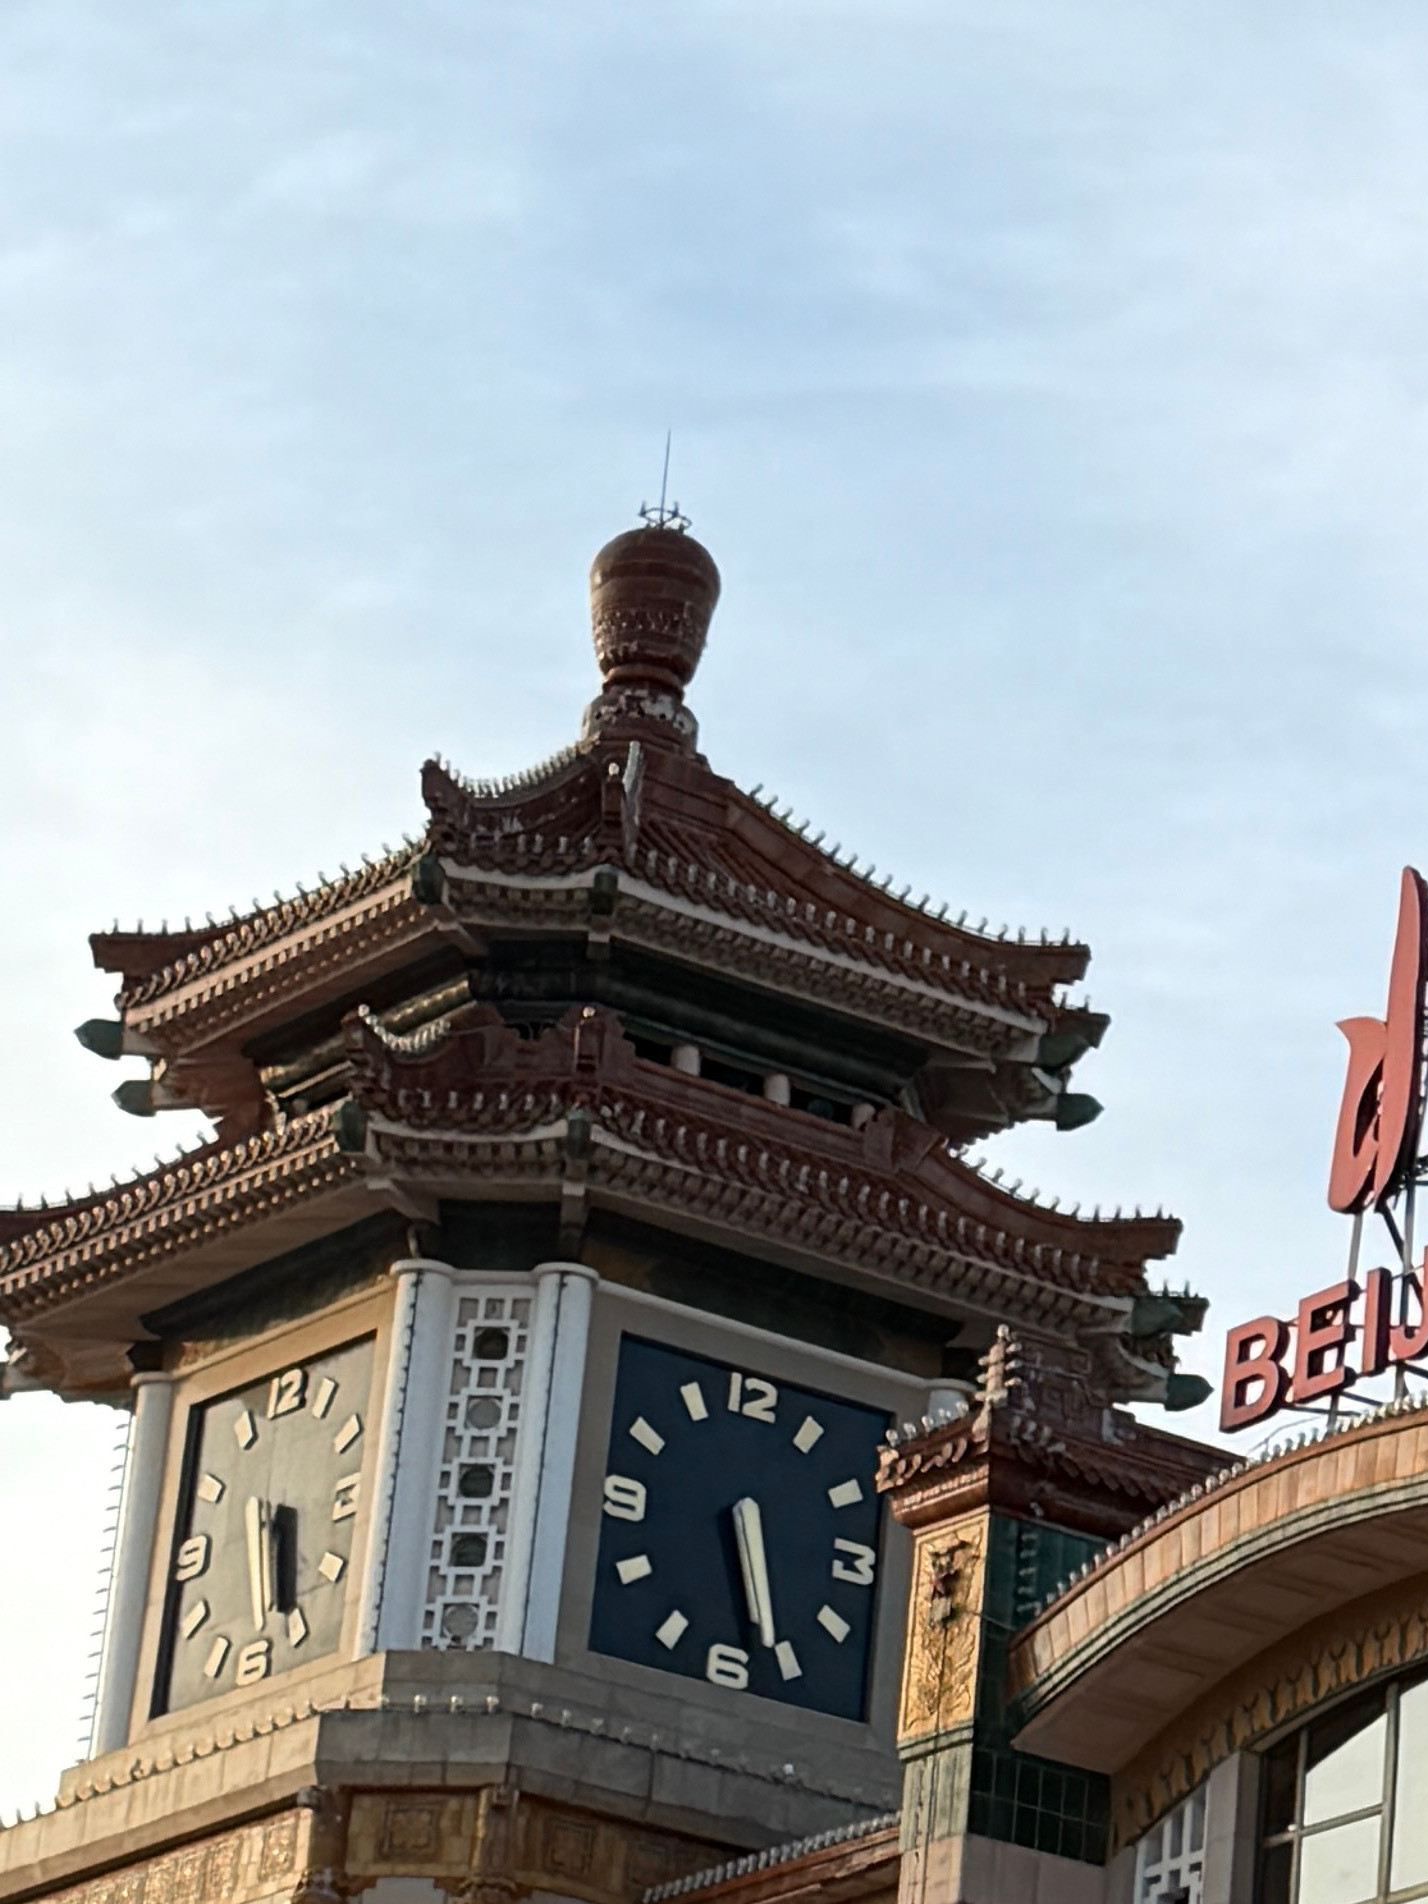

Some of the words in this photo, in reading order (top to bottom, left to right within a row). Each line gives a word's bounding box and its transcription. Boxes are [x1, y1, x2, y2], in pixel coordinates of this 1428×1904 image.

[267, 1369, 311, 1422] 12
[726, 1371, 779, 1425] 12
[603, 1474, 647, 1523] 9
[176, 1536, 211, 1582] 9
[832, 1538, 876, 1587] 3
[235, 1639, 272, 1686] 6
[706, 1644, 749, 1691] 6
